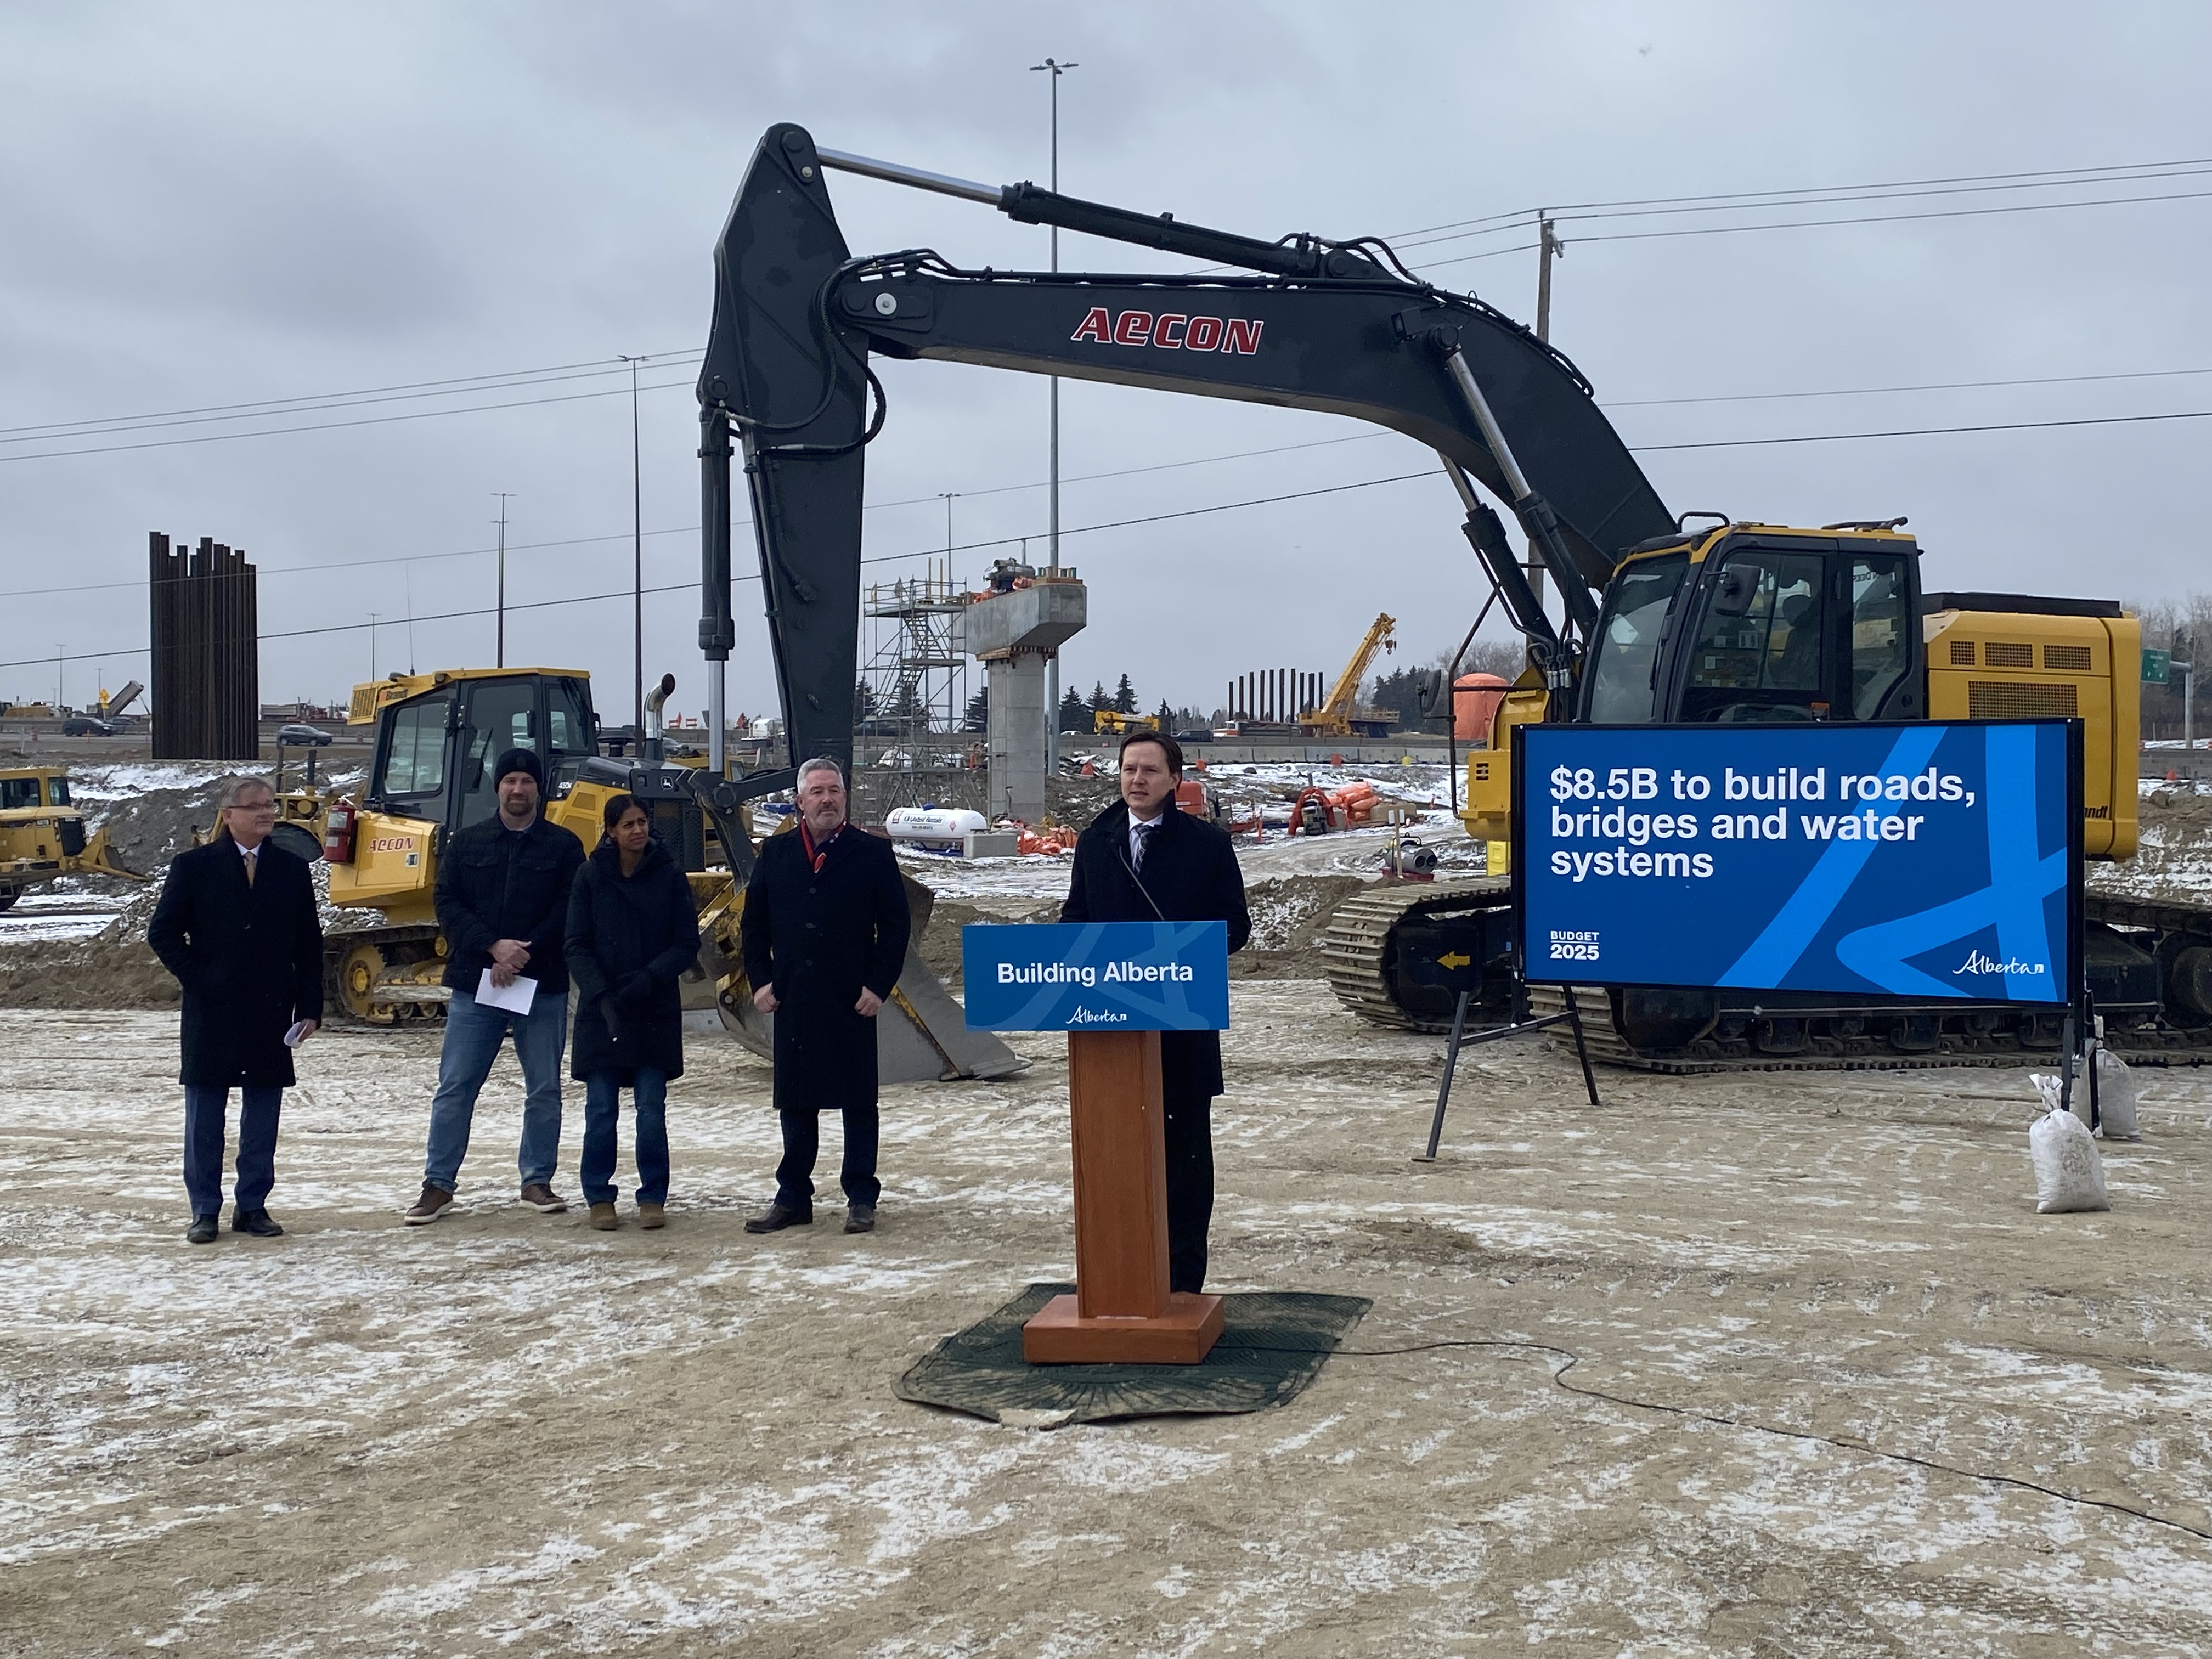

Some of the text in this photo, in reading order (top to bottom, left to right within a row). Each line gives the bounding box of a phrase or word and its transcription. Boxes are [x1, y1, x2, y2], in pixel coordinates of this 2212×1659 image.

[1550, 765, 1975, 808] $8.5B to build roads,
[1552, 806, 1925, 846] bridges and water
[1551, 847, 1714, 882] systems
[1550, 931, 1600, 941] BUDGET
[1550, 944, 1600, 961] 2025
[1953, 949, 2038, 975] Alberta
[998, 962, 1193, 987] Building Alberta
[1066, 1006, 1120, 1024] Alberta
